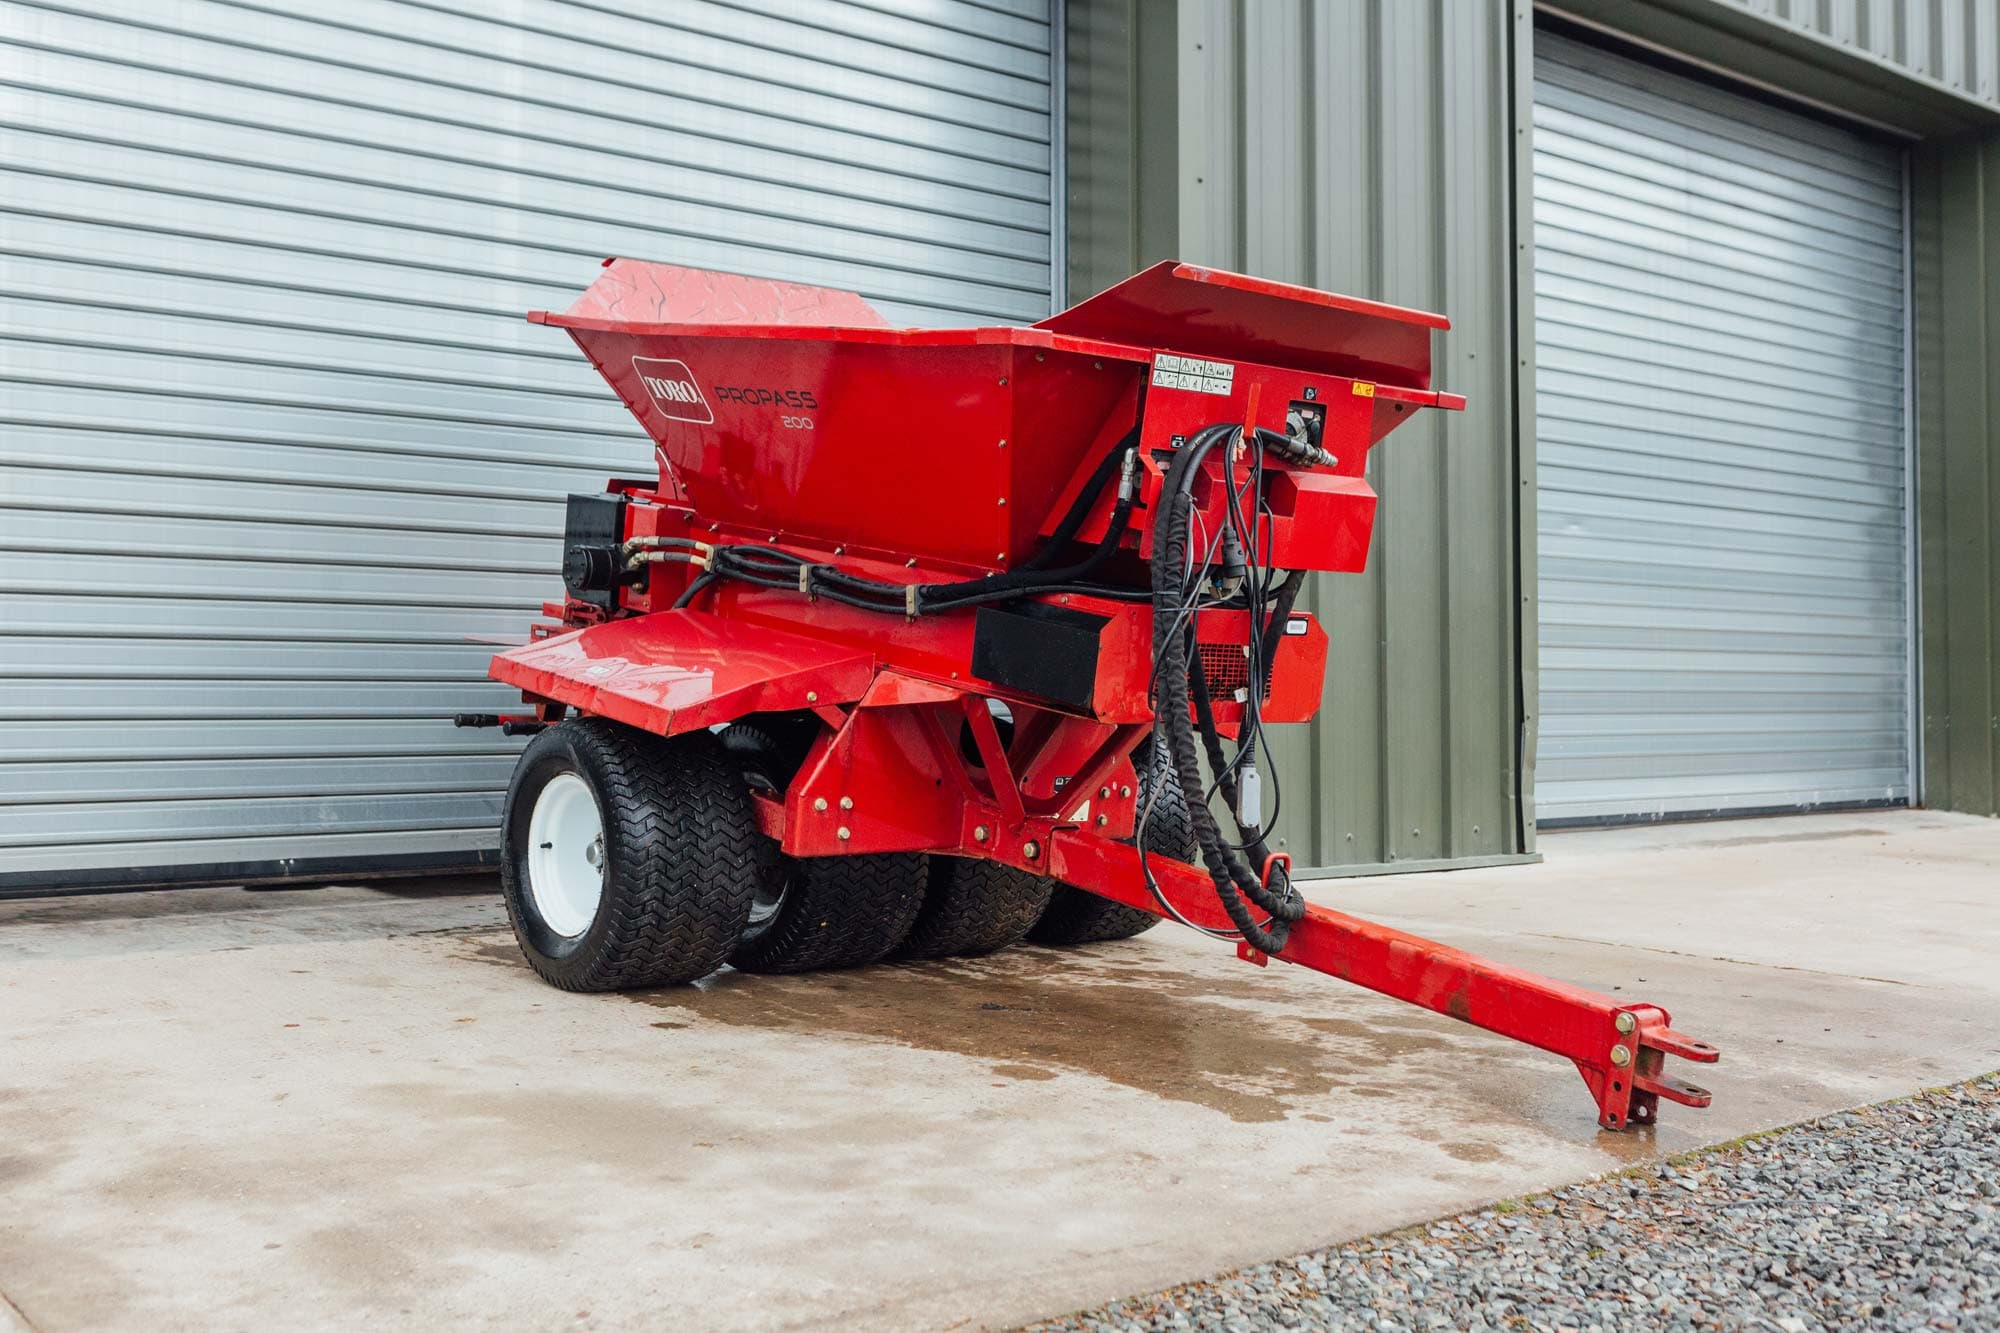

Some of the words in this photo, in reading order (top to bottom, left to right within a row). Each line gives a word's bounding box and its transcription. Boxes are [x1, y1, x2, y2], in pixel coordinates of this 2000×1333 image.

[644, 376, 698, 403] TORO
[714, 386, 818, 409] PROPASS
[780, 415, 815, 430] 200
